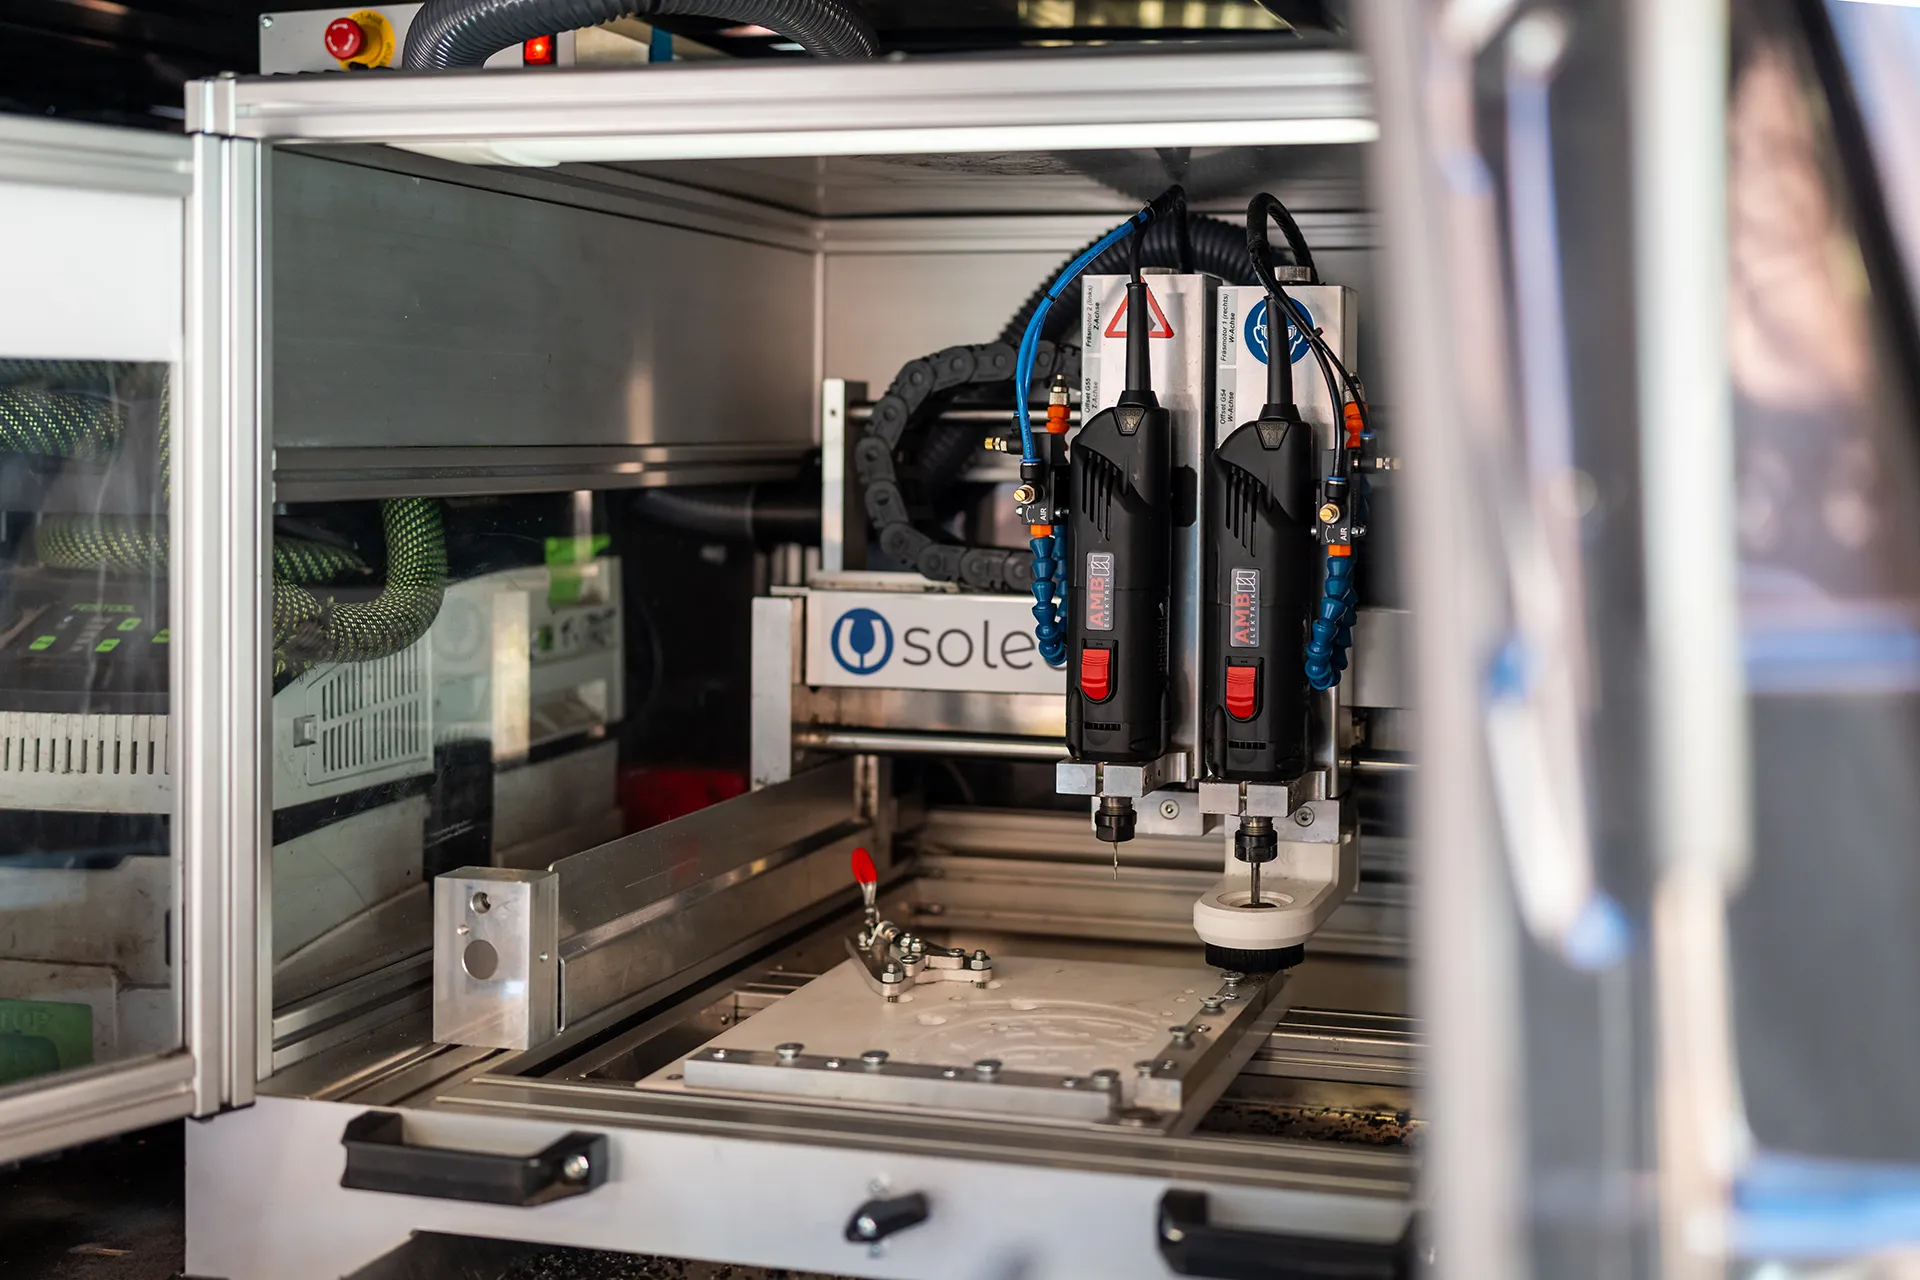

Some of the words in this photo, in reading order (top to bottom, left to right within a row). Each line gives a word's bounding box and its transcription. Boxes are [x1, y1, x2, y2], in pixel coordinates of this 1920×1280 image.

[1228, 312, 1236, 343] W-Achse
[1219, 403, 1227, 424] Offset
[1340, 527, 1348, 541] AIR
[1090, 577, 1105, 627] AMB
[1234, 593, 1250, 645] AMB
[902, 620, 1066, 671] sole
